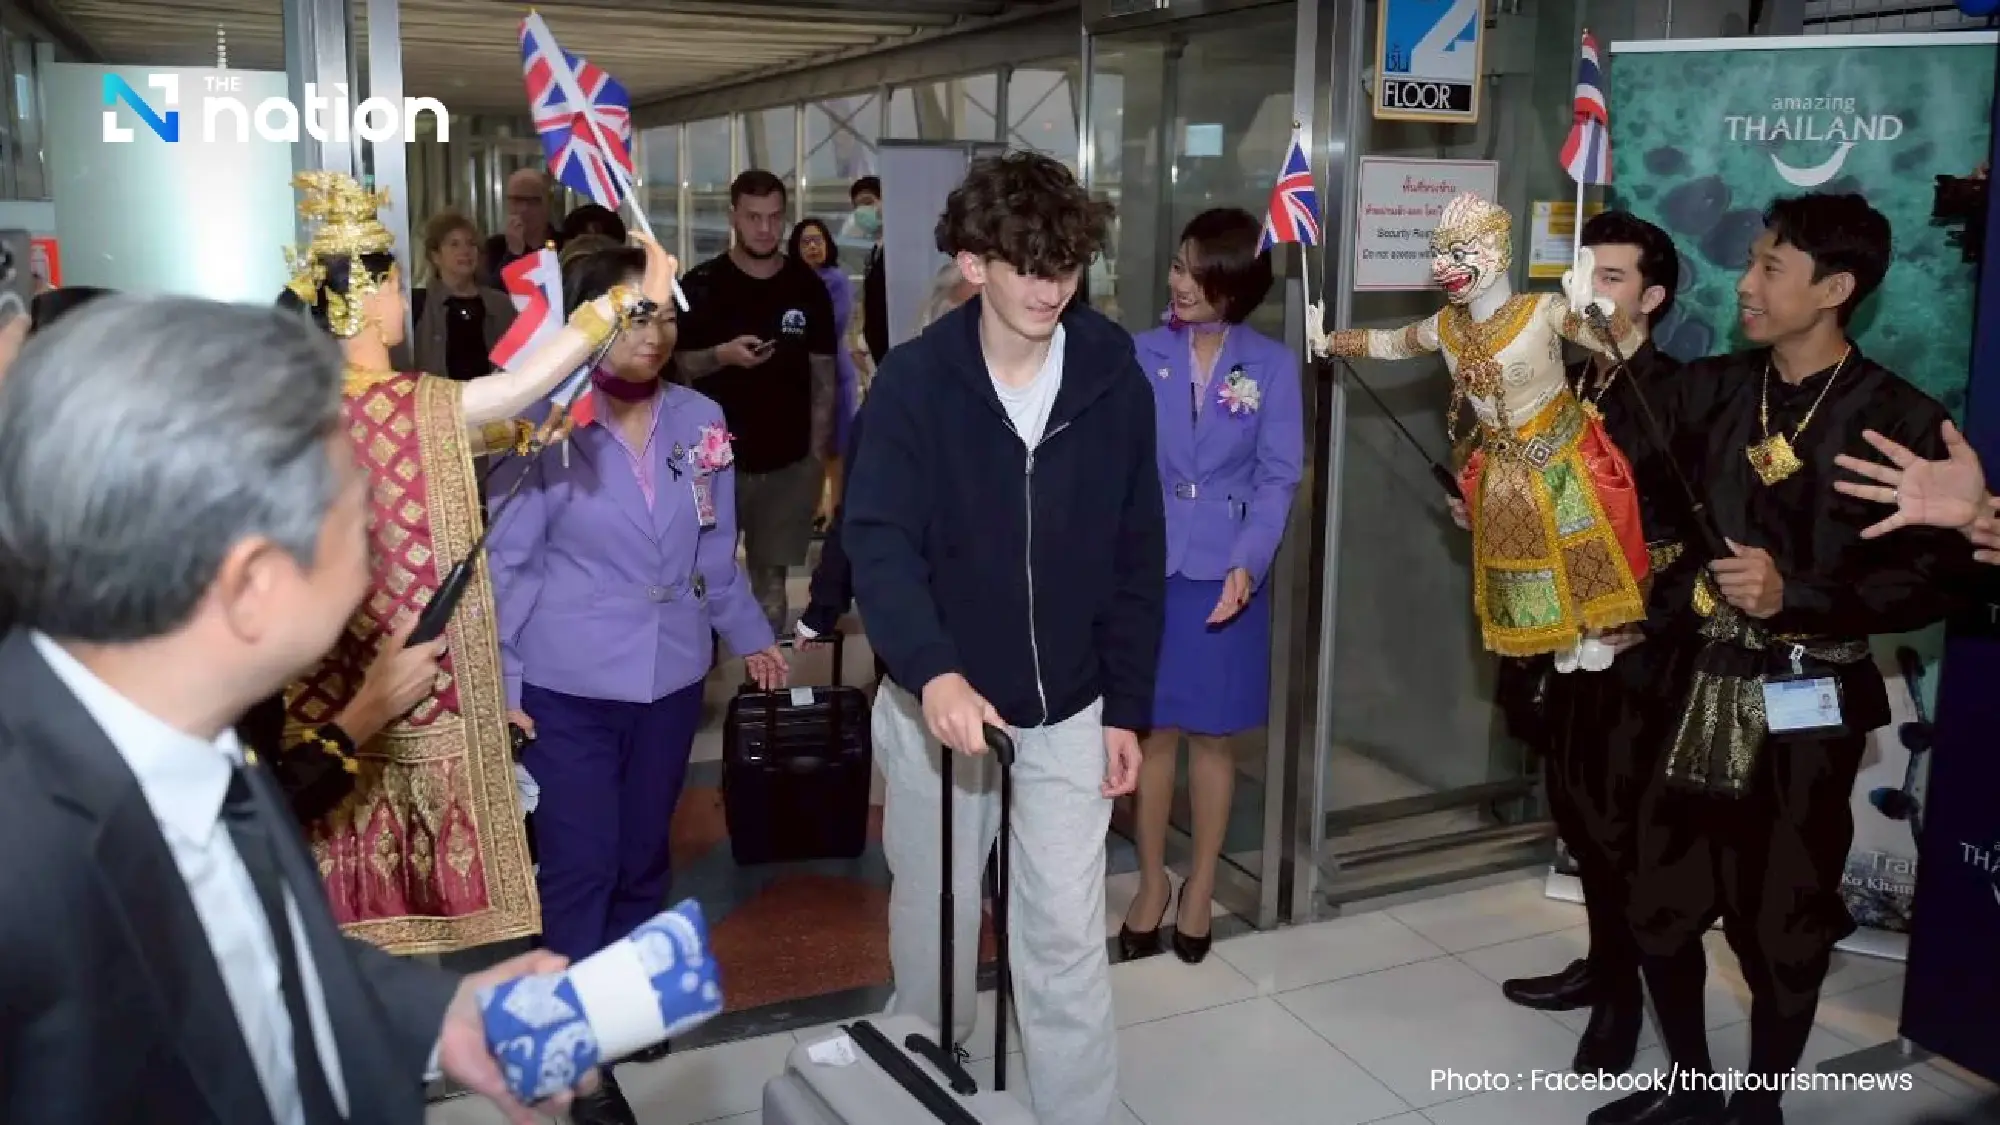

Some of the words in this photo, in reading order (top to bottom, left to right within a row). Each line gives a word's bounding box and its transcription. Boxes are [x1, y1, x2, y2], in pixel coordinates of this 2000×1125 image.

[1384, 81, 1451, 109] FLOOR
[1772, 93, 1856, 114] amazing
[1724, 114, 1904, 141] THAILAND
[1377, 228, 1410, 240] Security
[1959, 841, 2000, 873] THA
